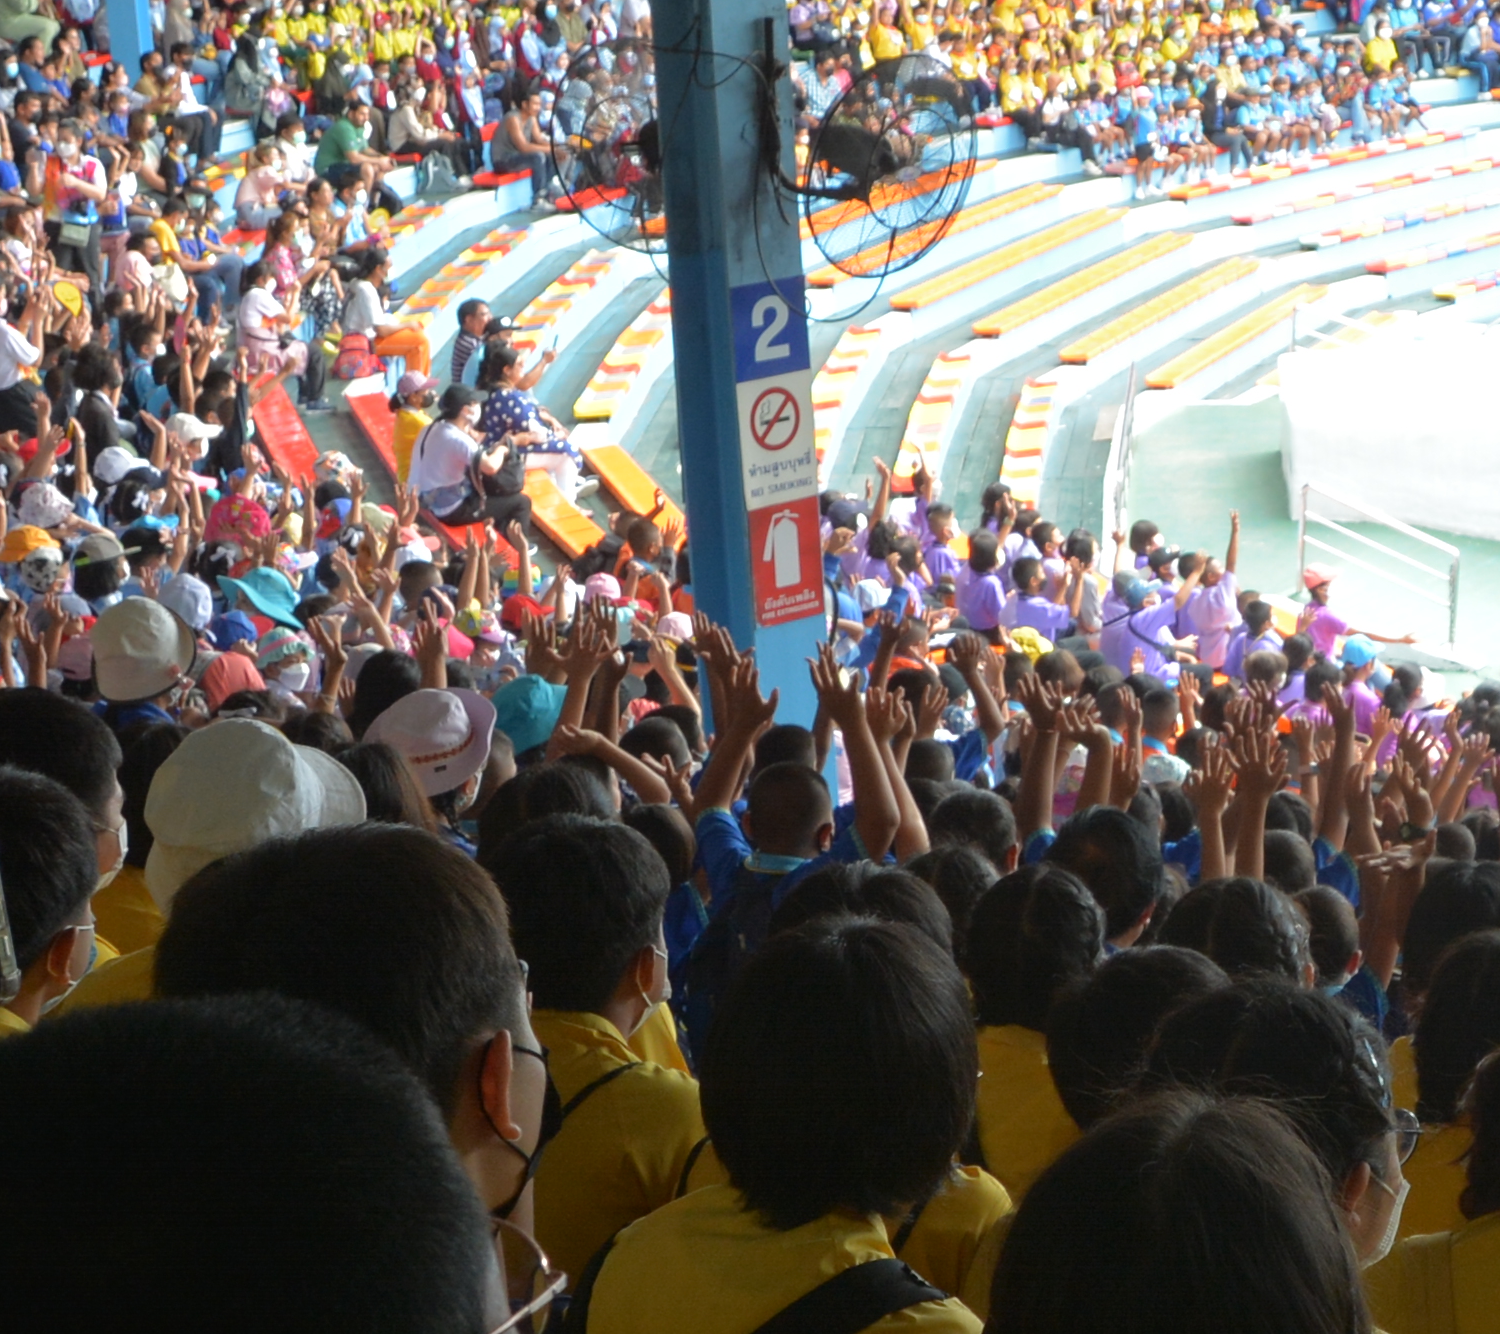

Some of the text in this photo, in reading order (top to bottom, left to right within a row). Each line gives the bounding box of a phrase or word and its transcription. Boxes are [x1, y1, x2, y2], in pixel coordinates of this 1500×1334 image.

[751, 295, 790, 362] 2
[748, 448, 812, 478] ห้ามสูบบุหรี่
[751, 476, 812, 497] NO SMOKING
[764, 589, 816, 610] ถังดับเพลิง
[762, 611, 776, 620] FIRE
